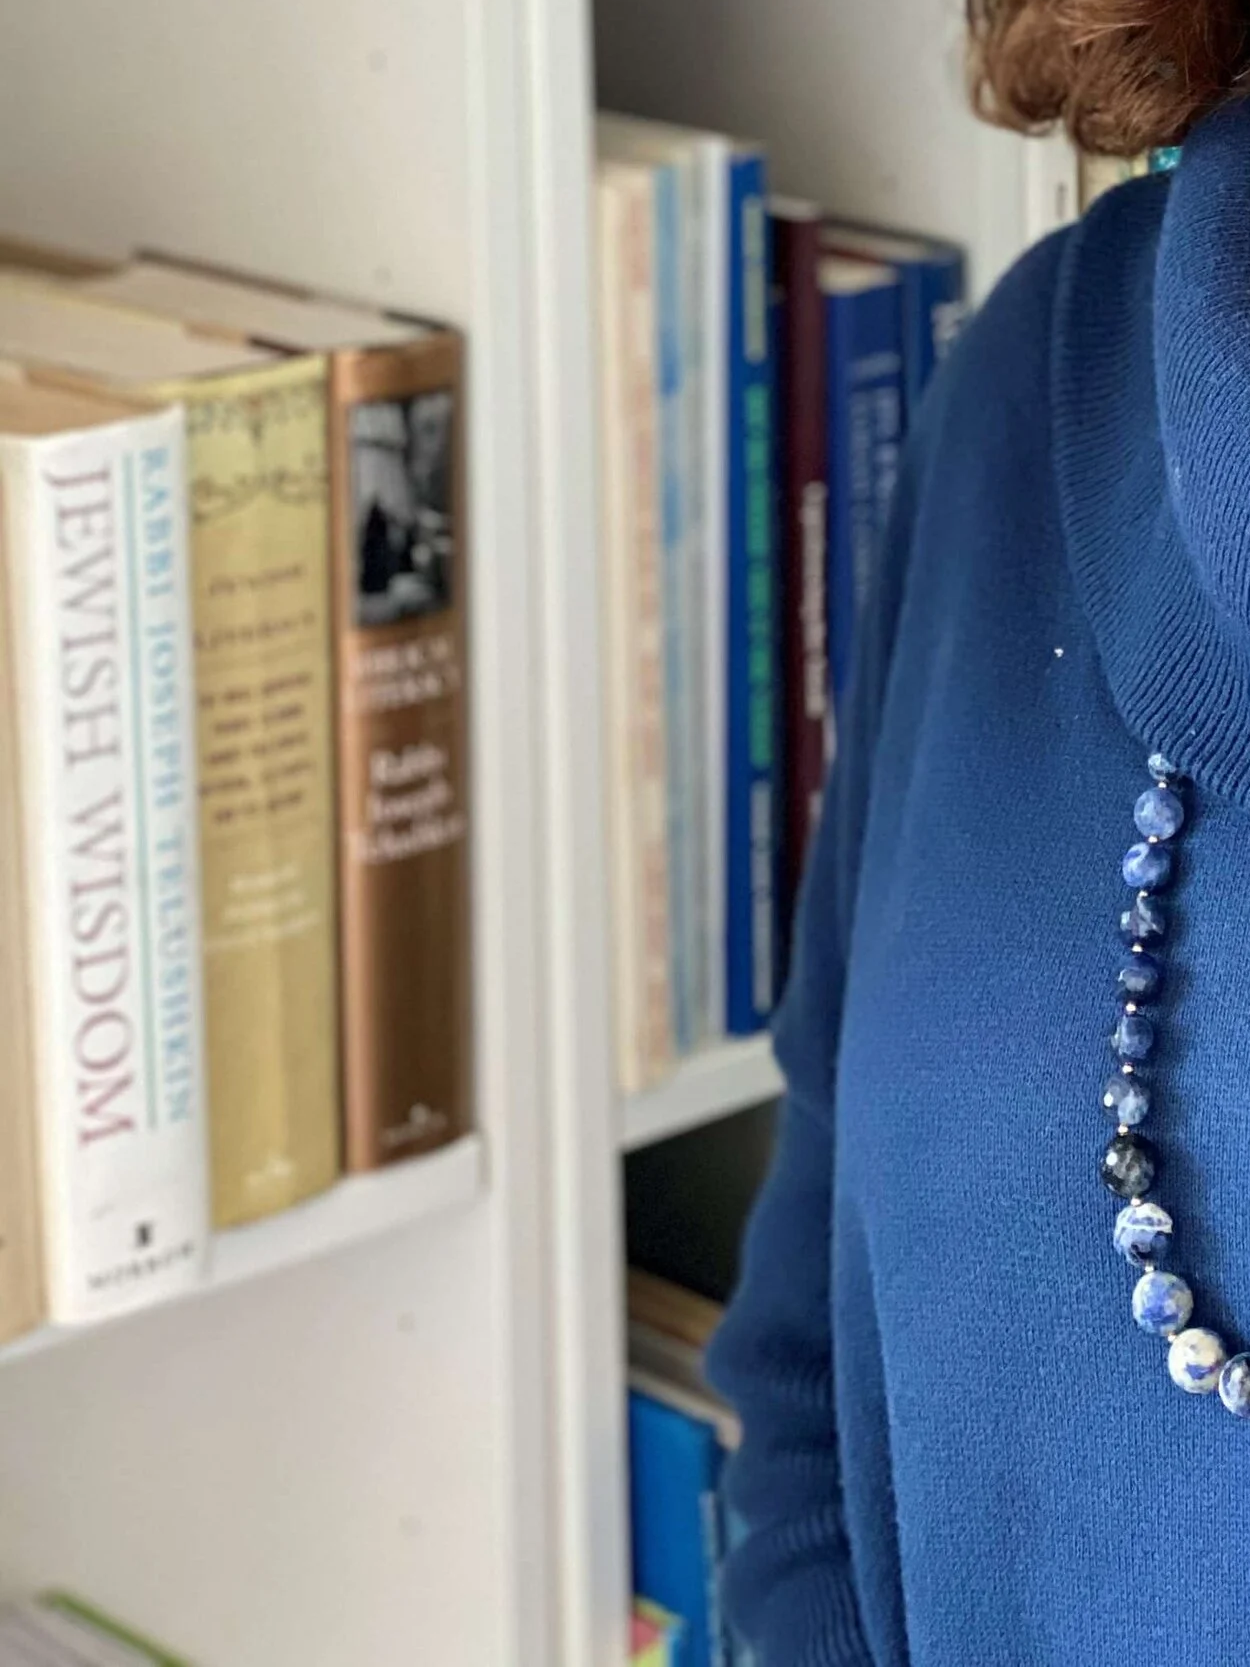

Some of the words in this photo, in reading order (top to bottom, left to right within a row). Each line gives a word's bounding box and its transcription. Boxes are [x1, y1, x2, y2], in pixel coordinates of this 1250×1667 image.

[44, 463, 121, 768] JEWISH
[140, 446, 175, 596] RABBI
[147, 621, 183, 809] JOSEPH
[67, 788, 136, 1149] WISDOM
[155, 824, 193, 1125] TELUSHKIN
